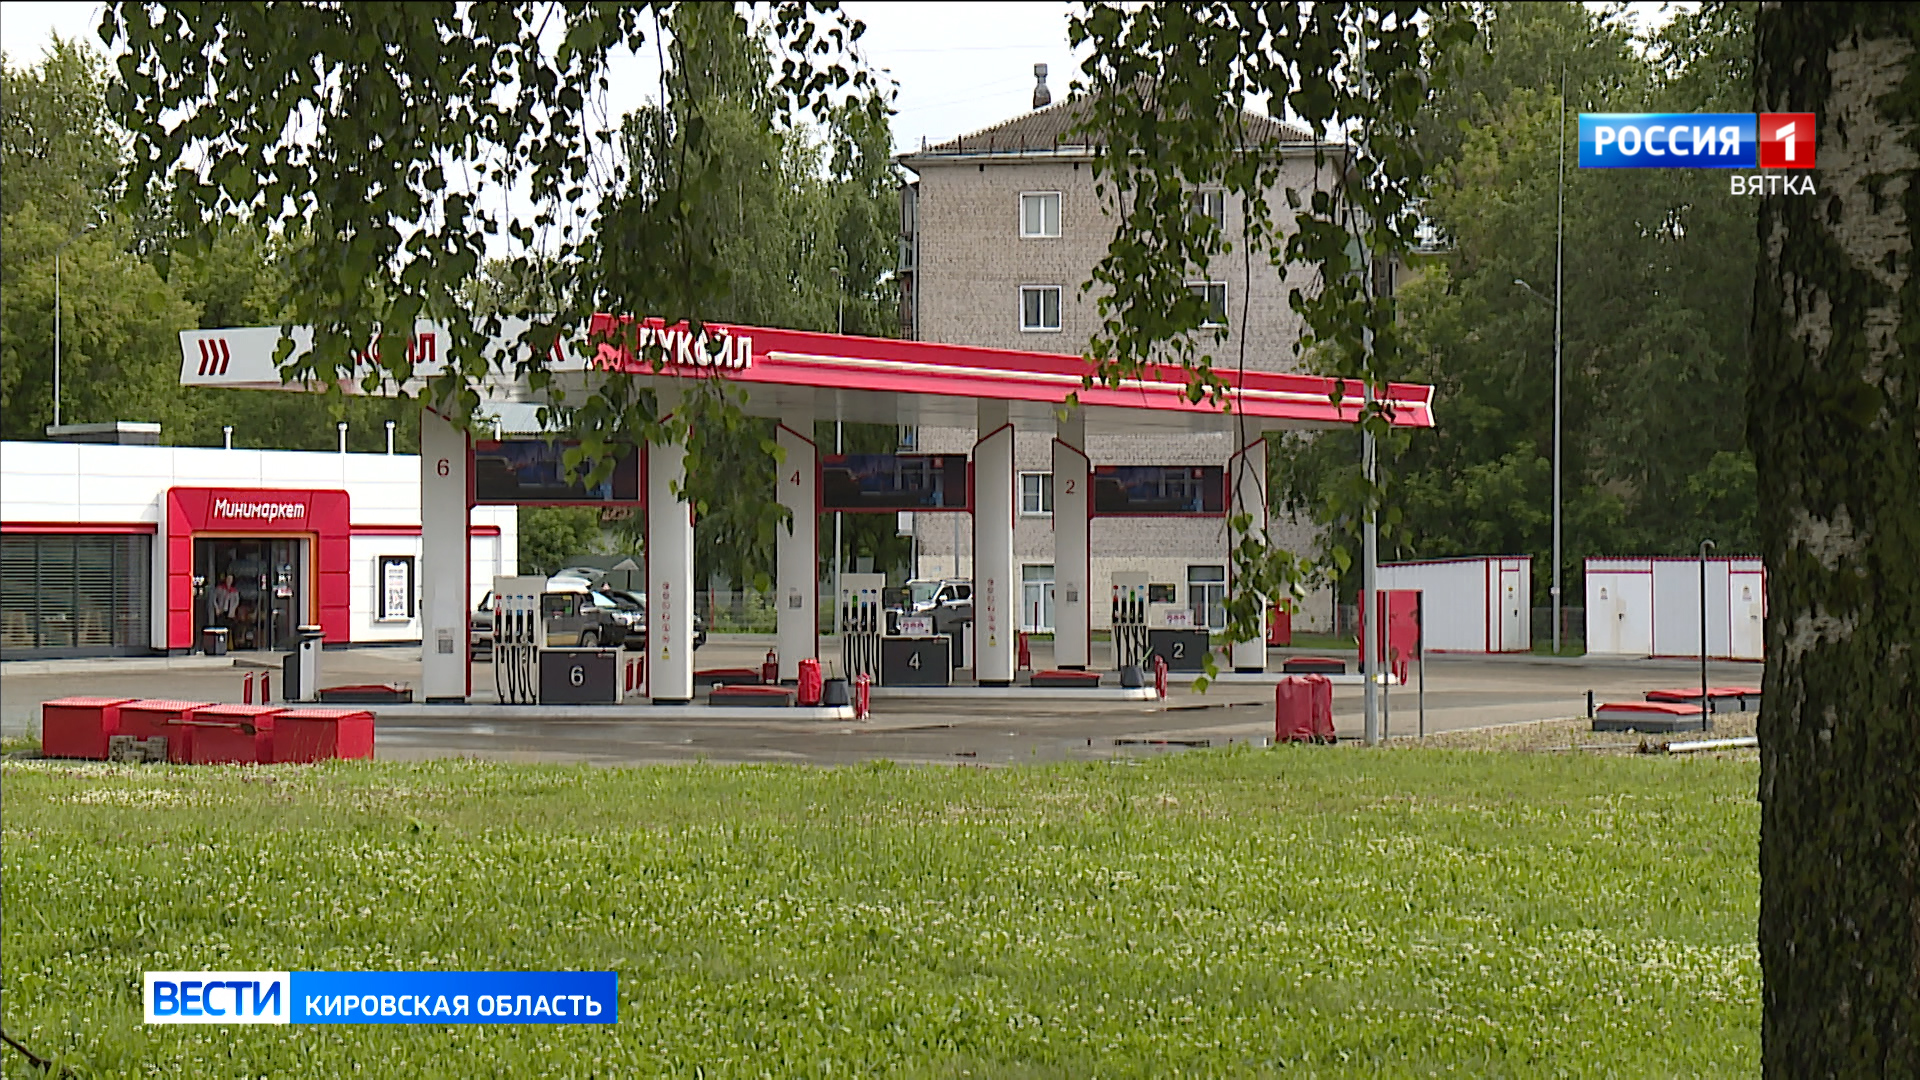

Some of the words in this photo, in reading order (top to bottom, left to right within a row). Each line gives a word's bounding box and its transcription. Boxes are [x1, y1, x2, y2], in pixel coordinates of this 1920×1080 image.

[437, 458, 449, 477] 6
[790, 470, 800, 486] 4
[1065, 479, 1075, 494] 2
[214, 498, 305, 523] Минимаркет
[1173, 642, 1184, 659] 2
[908, 651, 921, 670] 4
[570, 666, 584, 687] 6
